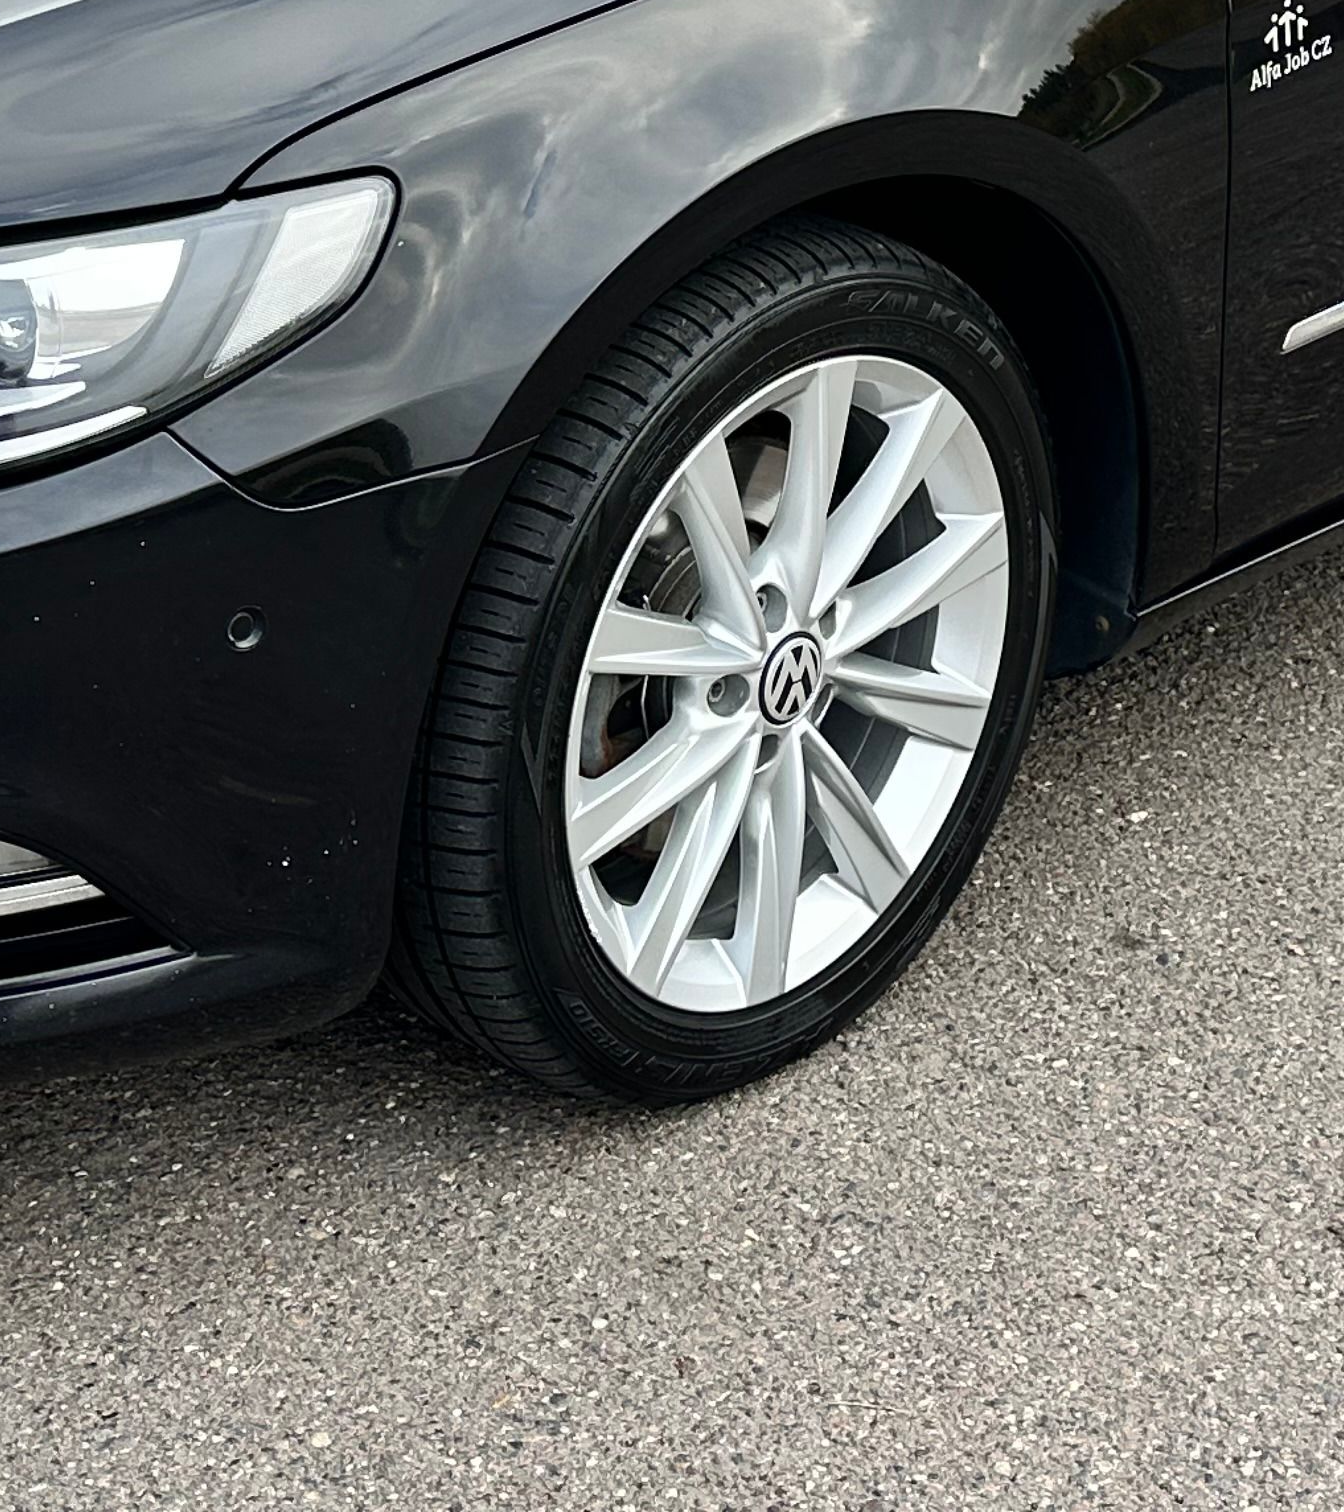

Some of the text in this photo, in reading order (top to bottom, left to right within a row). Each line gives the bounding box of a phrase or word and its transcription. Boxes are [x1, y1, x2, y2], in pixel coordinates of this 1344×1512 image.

[1250, 35, 1333, 91] Alfa Job CZ
